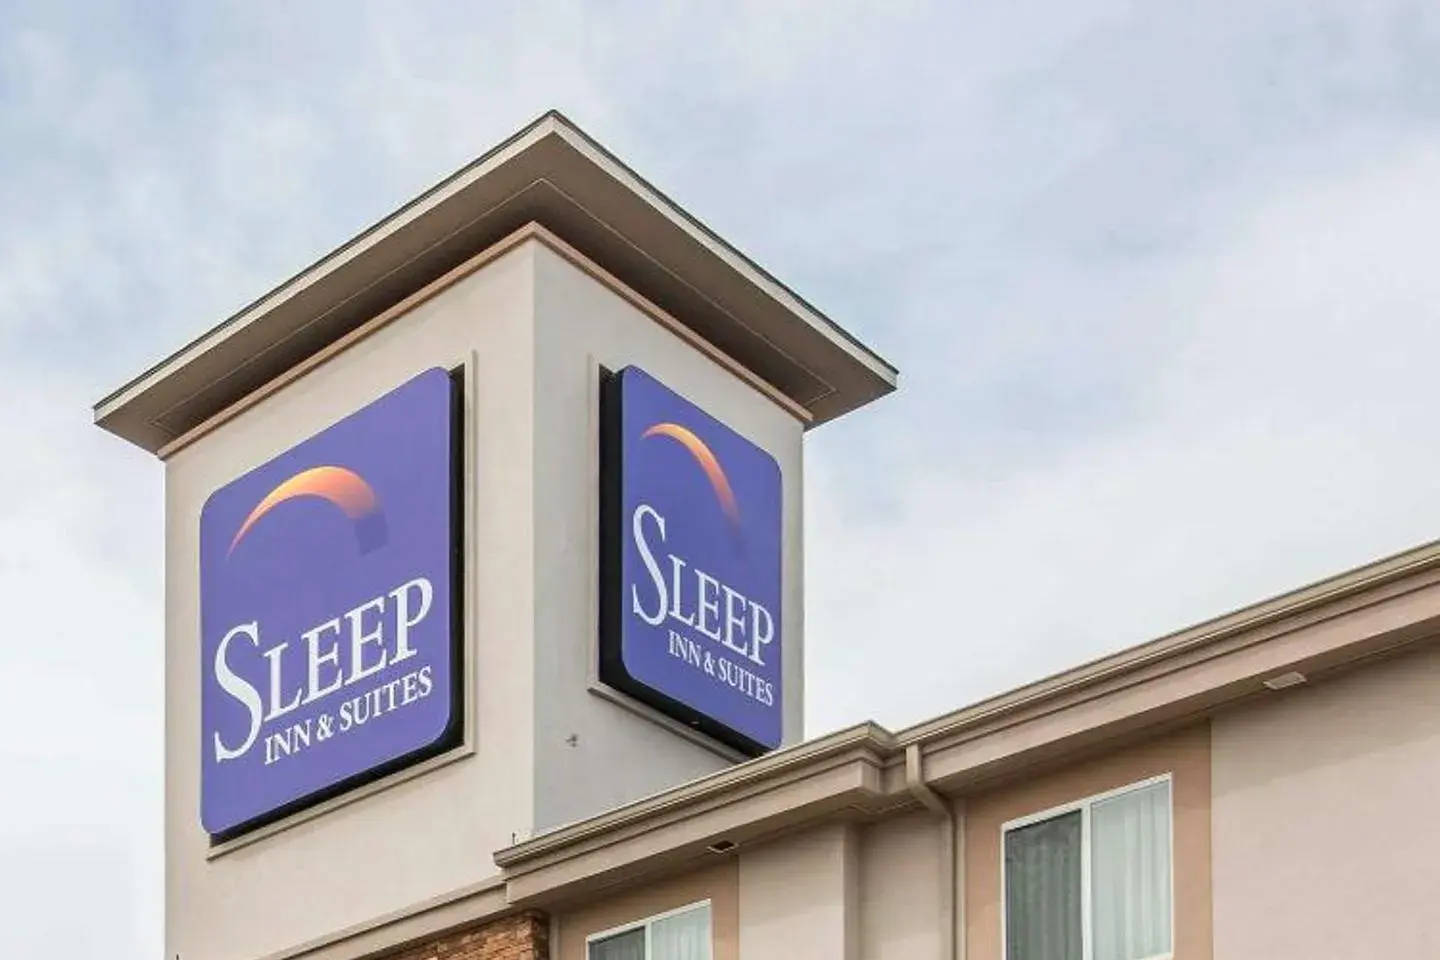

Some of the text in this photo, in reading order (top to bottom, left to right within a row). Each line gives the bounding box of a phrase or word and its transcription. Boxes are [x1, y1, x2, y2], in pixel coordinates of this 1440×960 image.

[632, 504, 775, 666] SLEEP
[214, 576, 433, 763] SLEEP
[264, 665, 433, 765] INN & SUITES
[668, 629, 773, 707] INN & SUITES
